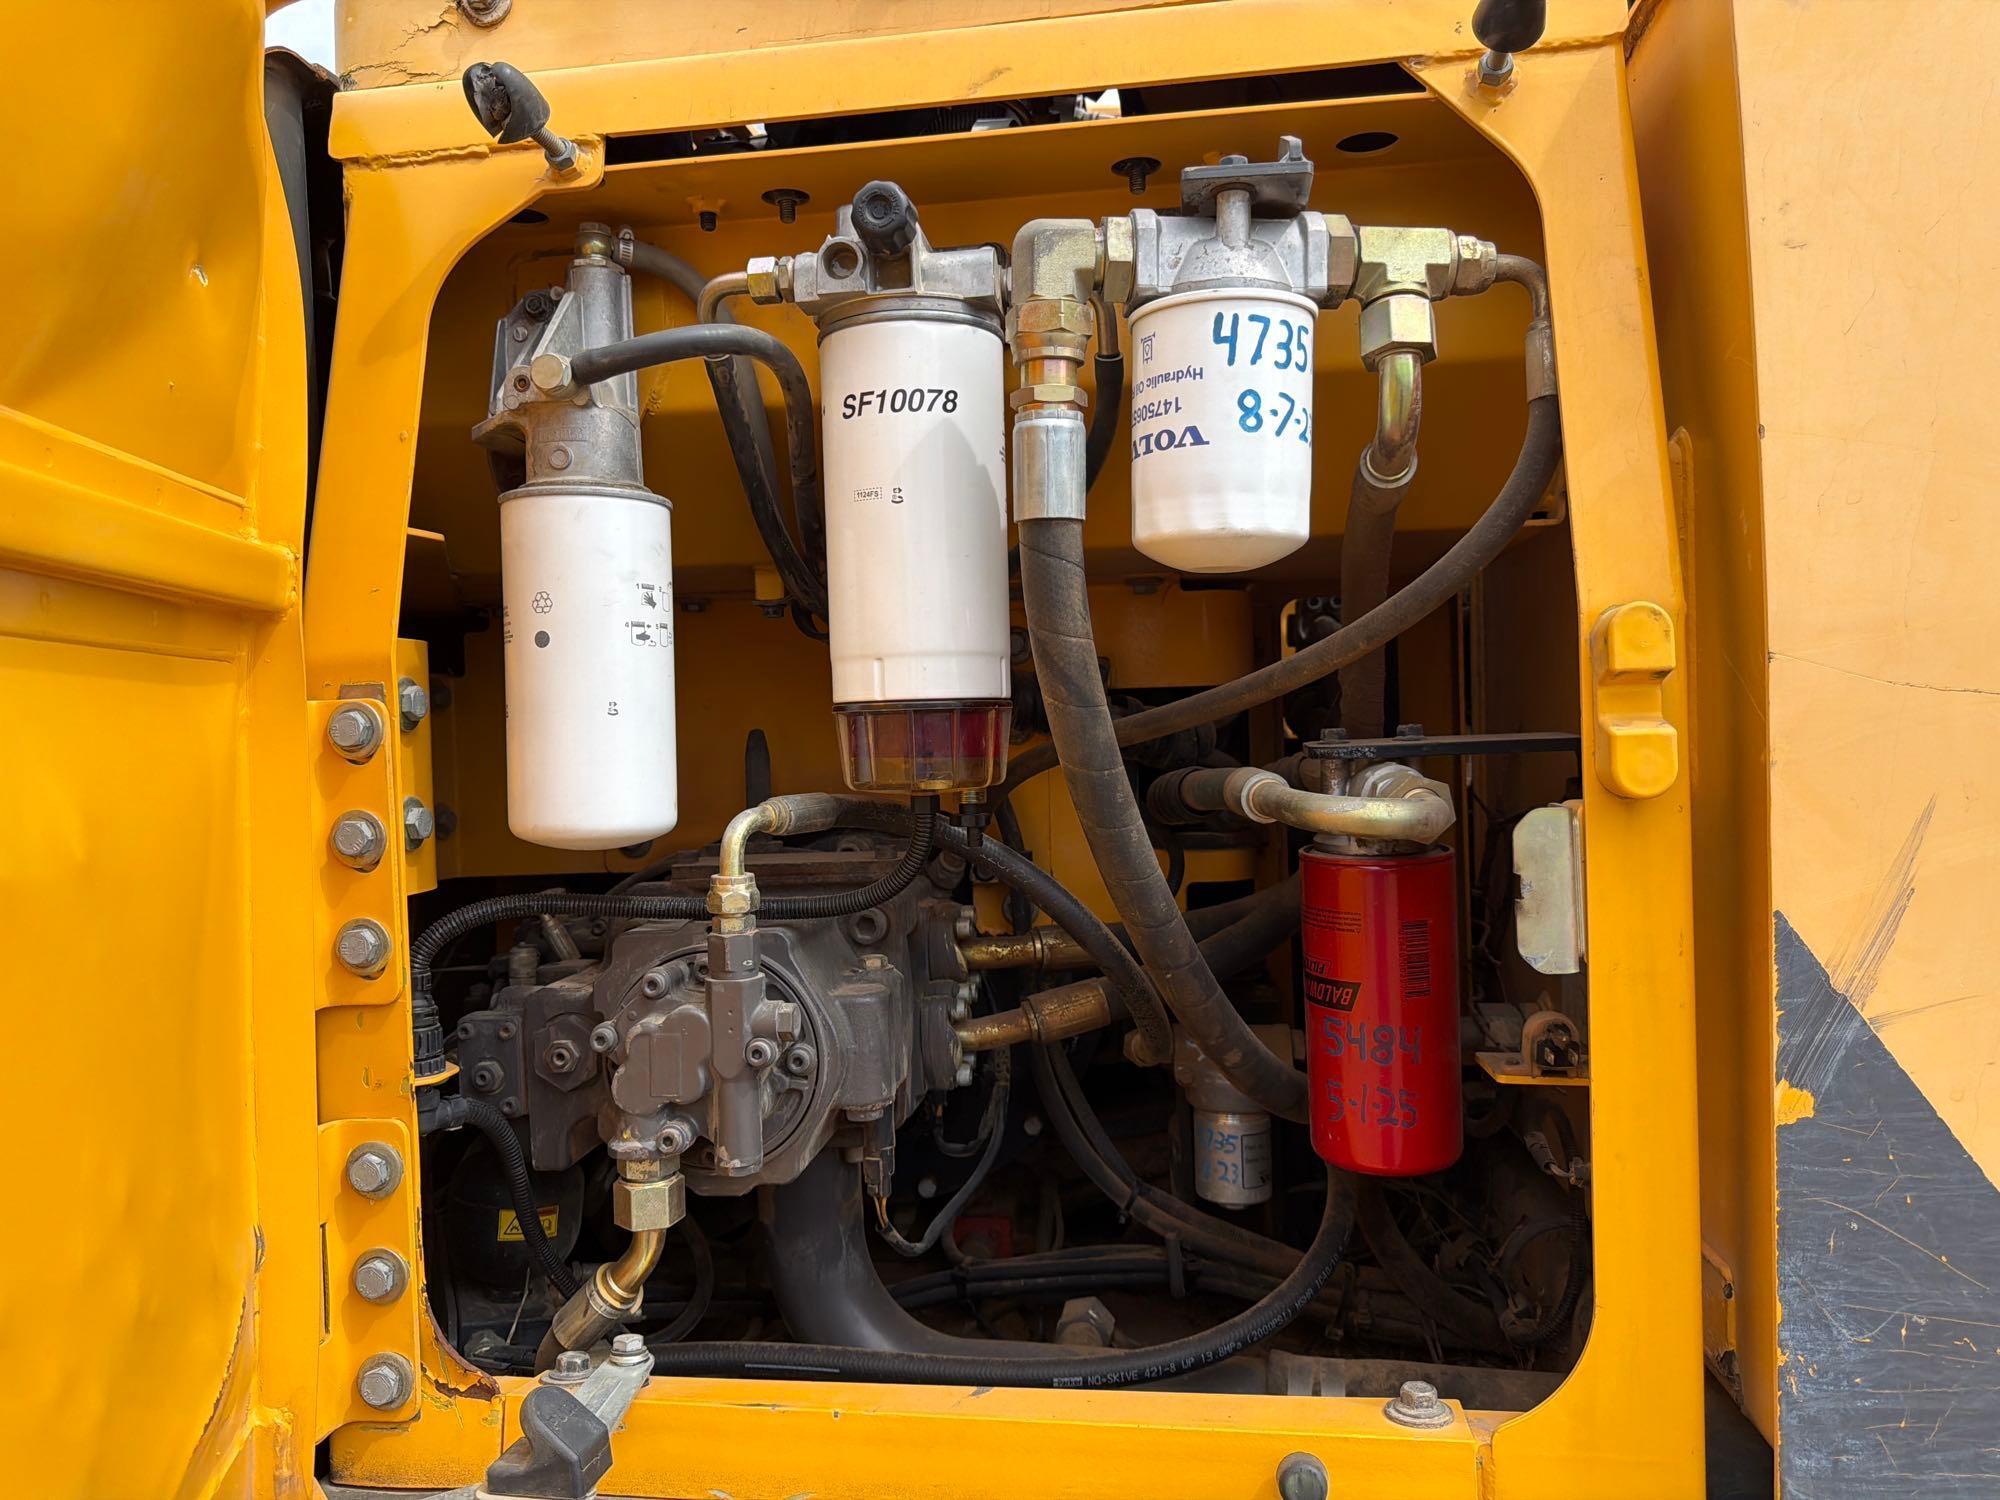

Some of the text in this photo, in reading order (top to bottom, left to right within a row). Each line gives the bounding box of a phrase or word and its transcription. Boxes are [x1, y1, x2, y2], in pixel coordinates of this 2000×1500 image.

[1212, 311, 1309, 373] 4735
[1145, 365, 1204, 389] Hydraulic
[842, 388, 959, 420] SF10078
[1237, 388, 1312, 449] 8-7-2
[1323, 1016, 1422, 1066] 5484
